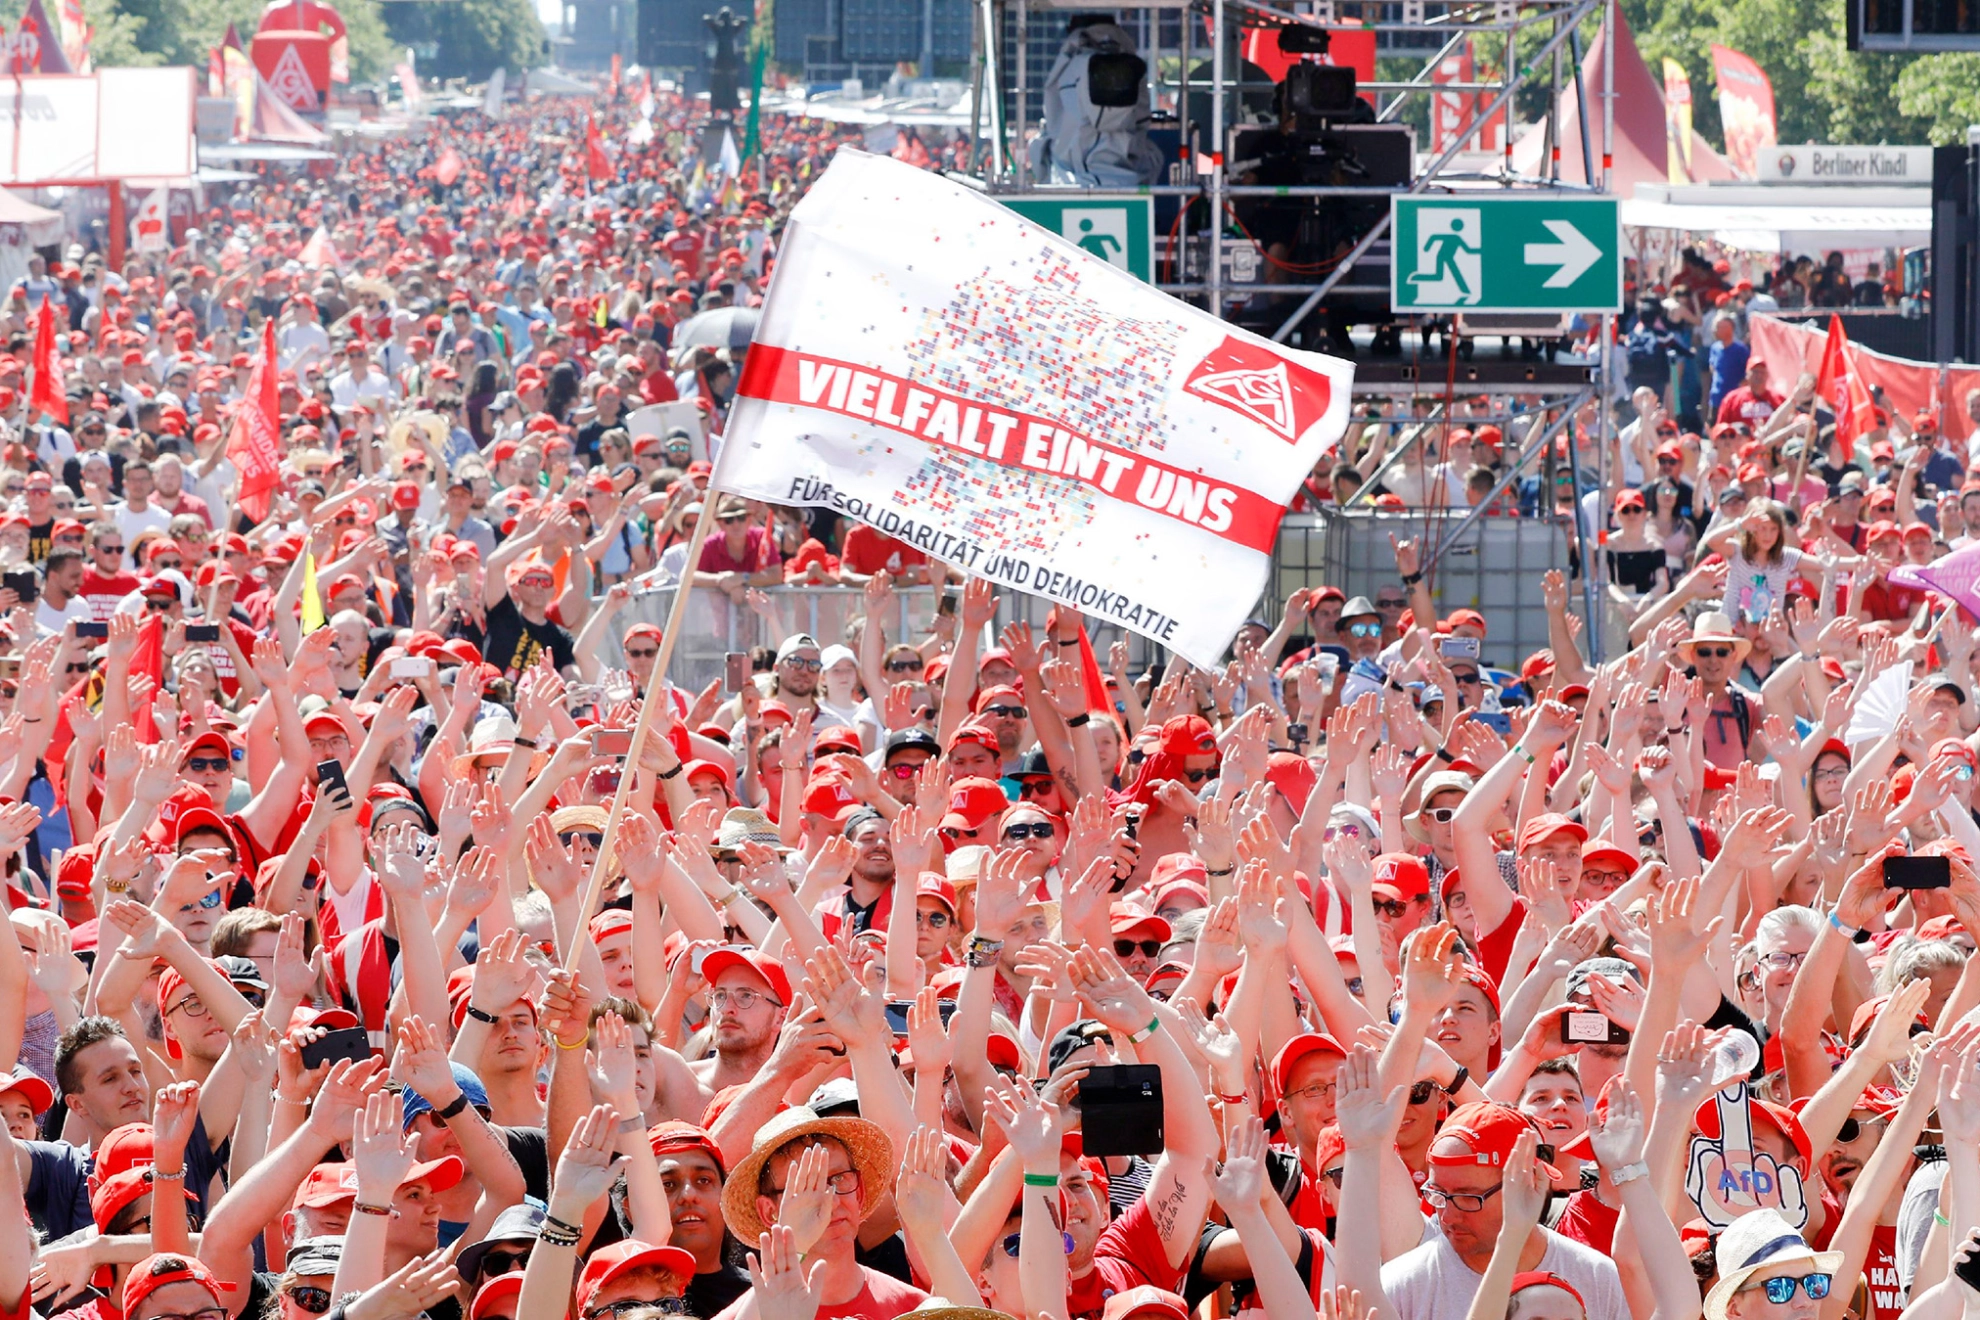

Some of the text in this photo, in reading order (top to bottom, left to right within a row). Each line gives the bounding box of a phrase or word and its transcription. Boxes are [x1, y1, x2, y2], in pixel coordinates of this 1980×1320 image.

[1813, 152, 1908, 176] Berliner Kindl
[799, 359, 1238, 532] VIELFALT EINT UNS
[788, 475, 1179, 641] FÜR SOLIDARITÄT UND DEMOKRATIE
[1717, 1169, 1773, 1193] AfD
